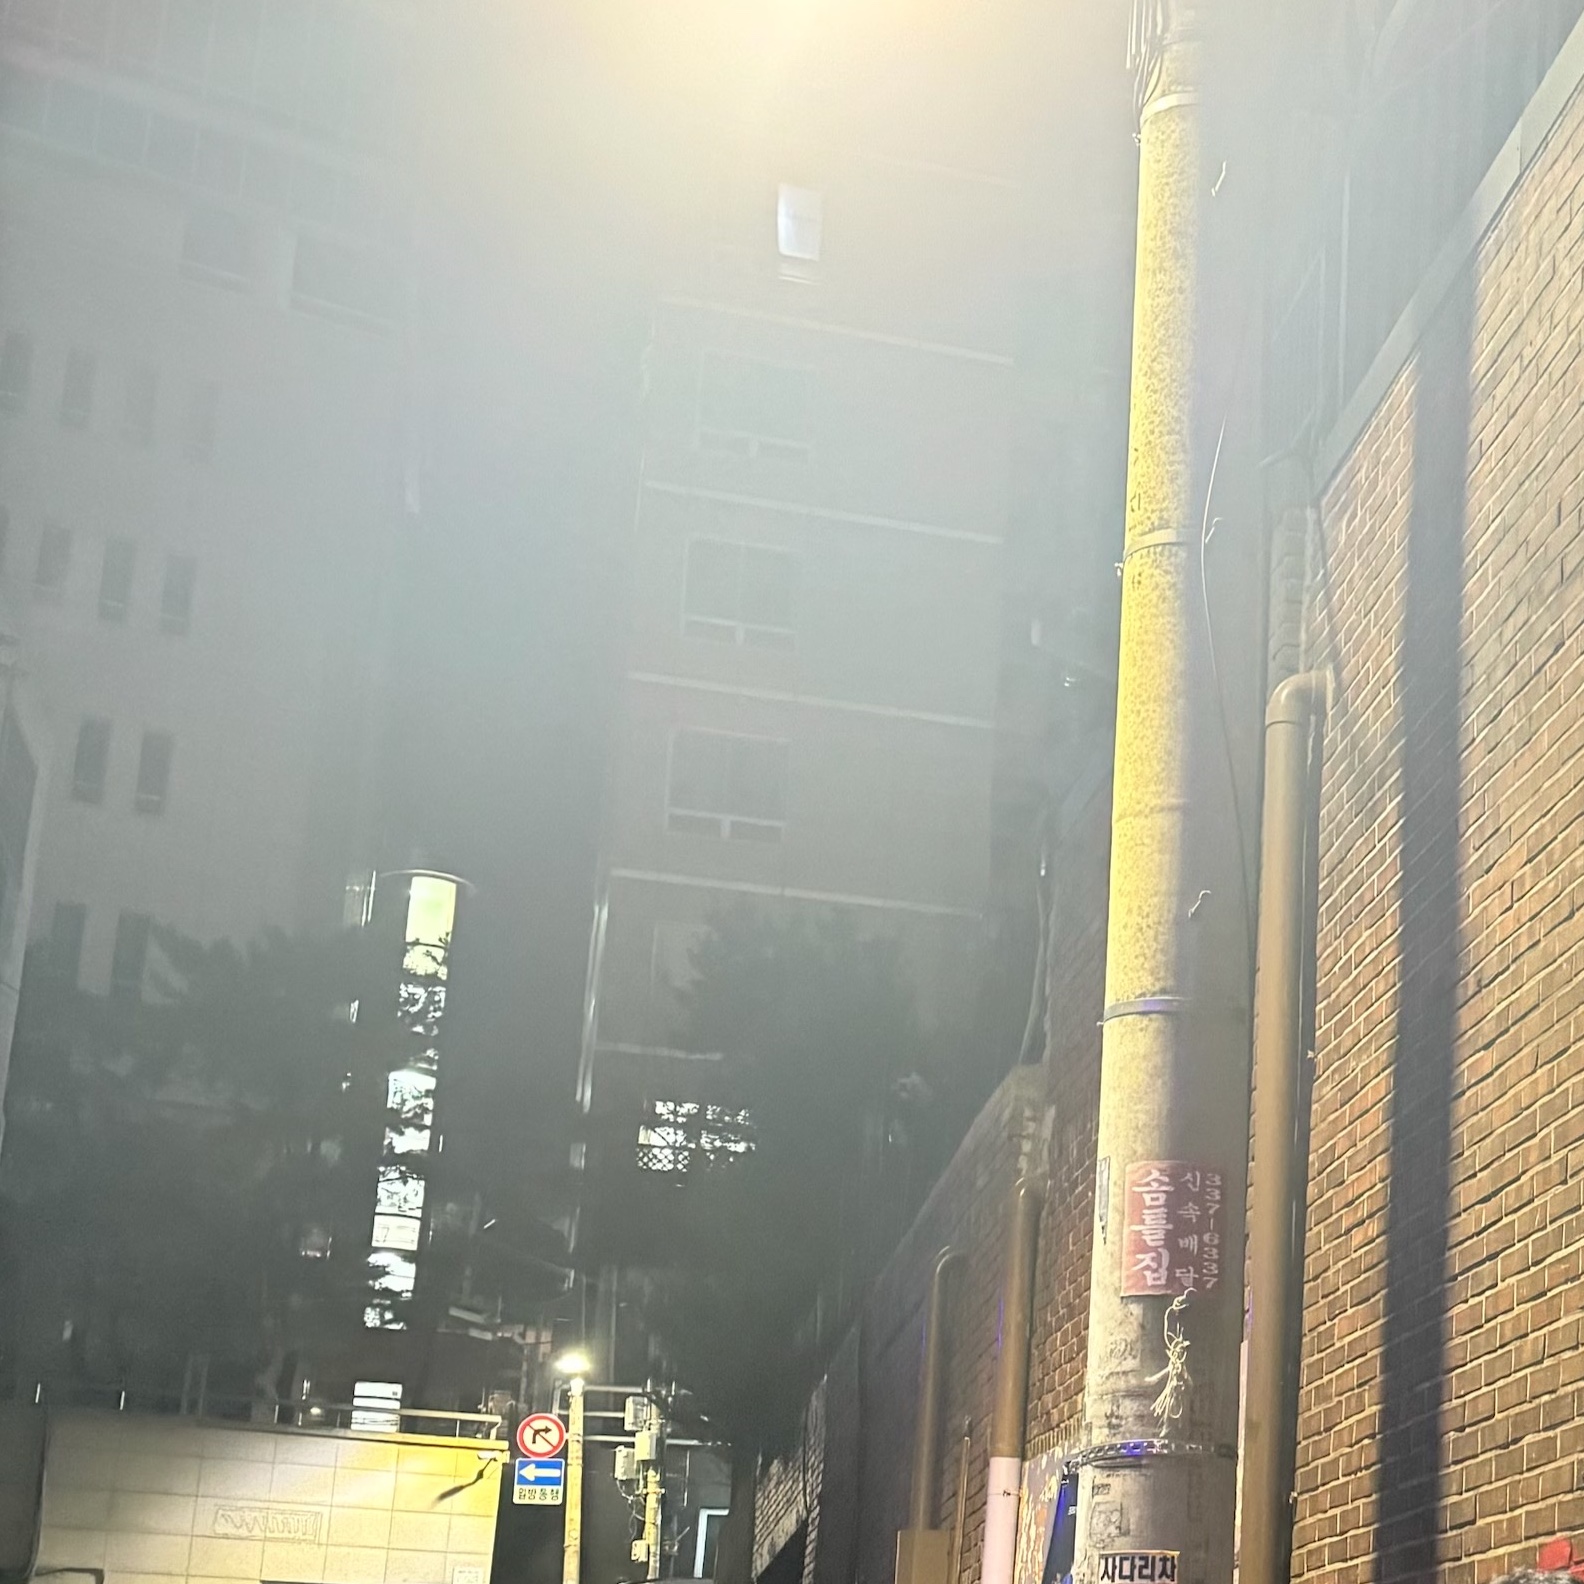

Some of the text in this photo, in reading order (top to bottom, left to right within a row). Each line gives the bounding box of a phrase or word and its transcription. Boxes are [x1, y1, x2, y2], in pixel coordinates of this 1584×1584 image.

[1131, 1169, 1175, 1287] 솜틀집
[1175, 1170, 1201, 1287] 신속배달
[1202, 1173, 1222, 1289] 337-6337
[1100, 1554, 1177, 1583] 사다리차
